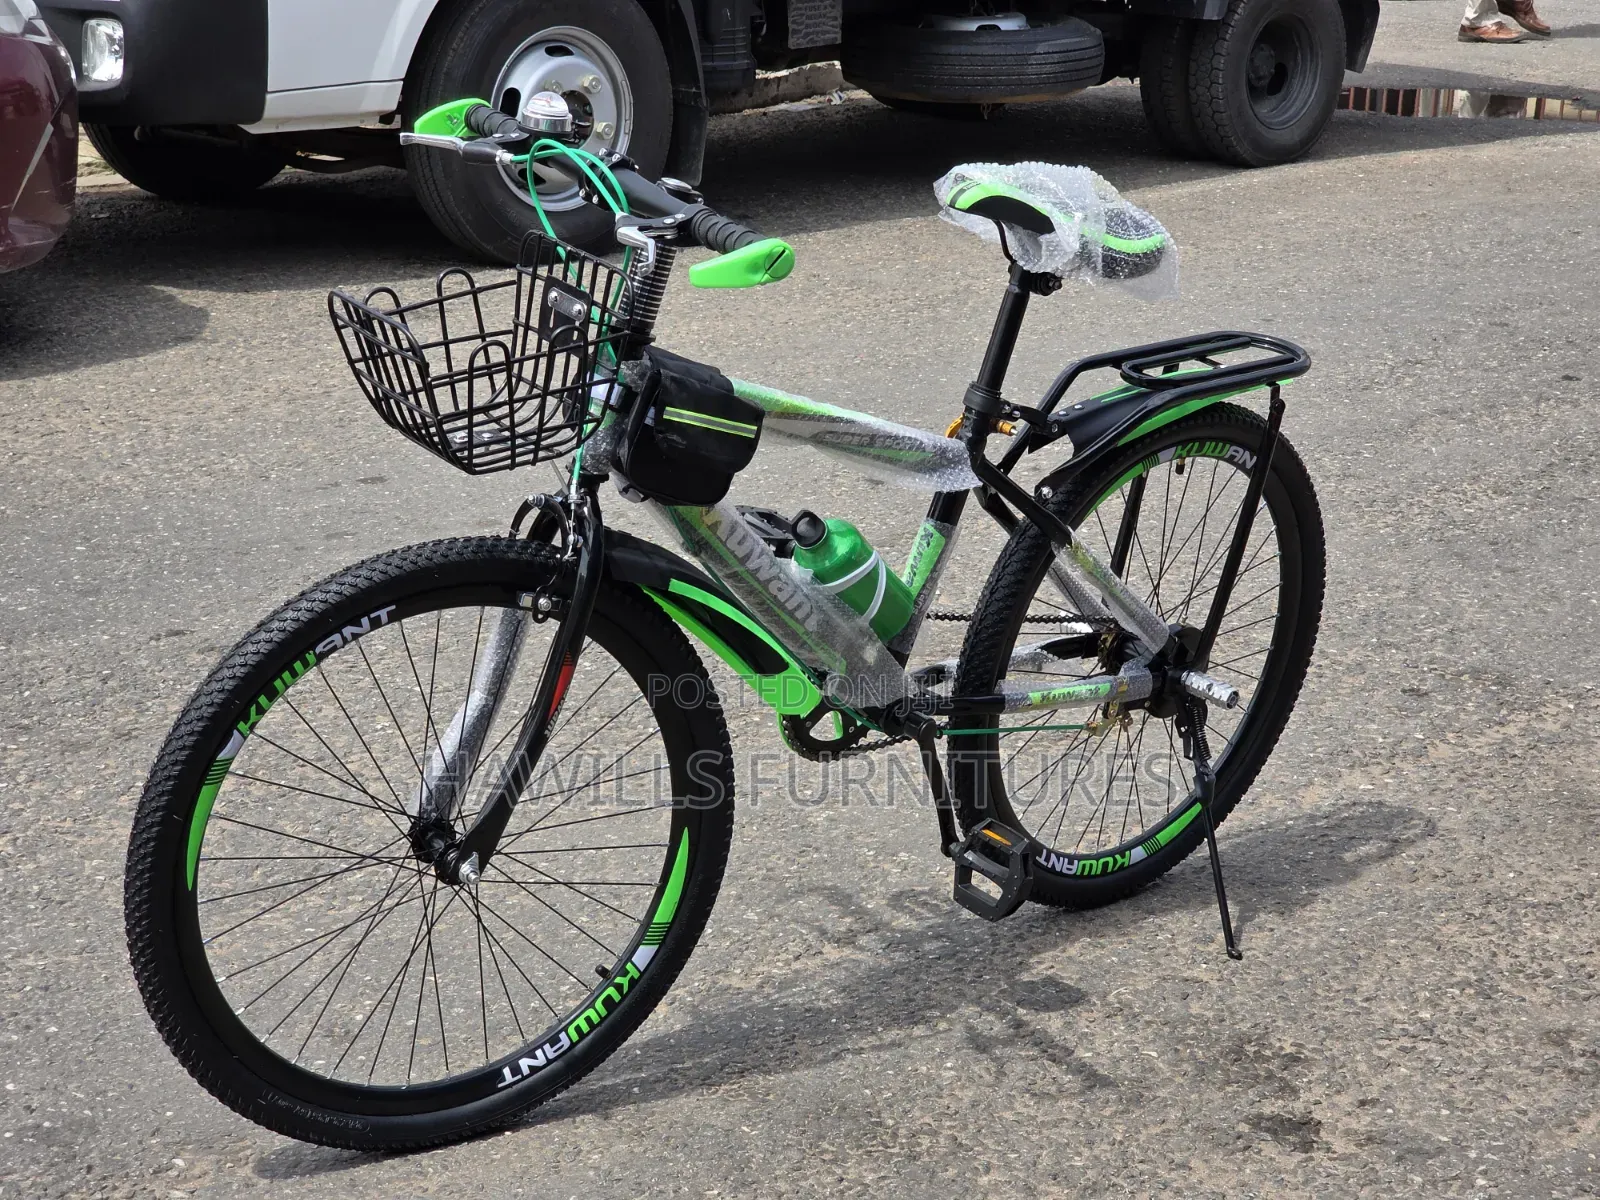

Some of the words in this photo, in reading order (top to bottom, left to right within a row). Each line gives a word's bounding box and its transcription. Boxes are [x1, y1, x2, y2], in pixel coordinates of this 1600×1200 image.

[823, 431, 871, 447] SUPER
[1172, 441, 1258, 470] KUWAN
[904, 526, 935, 588] Kuwa
[237, 604, 397, 738] KUWANT
[1036, 848, 1131, 876] KUWANT
[497, 961, 641, 1089] KUWANT
